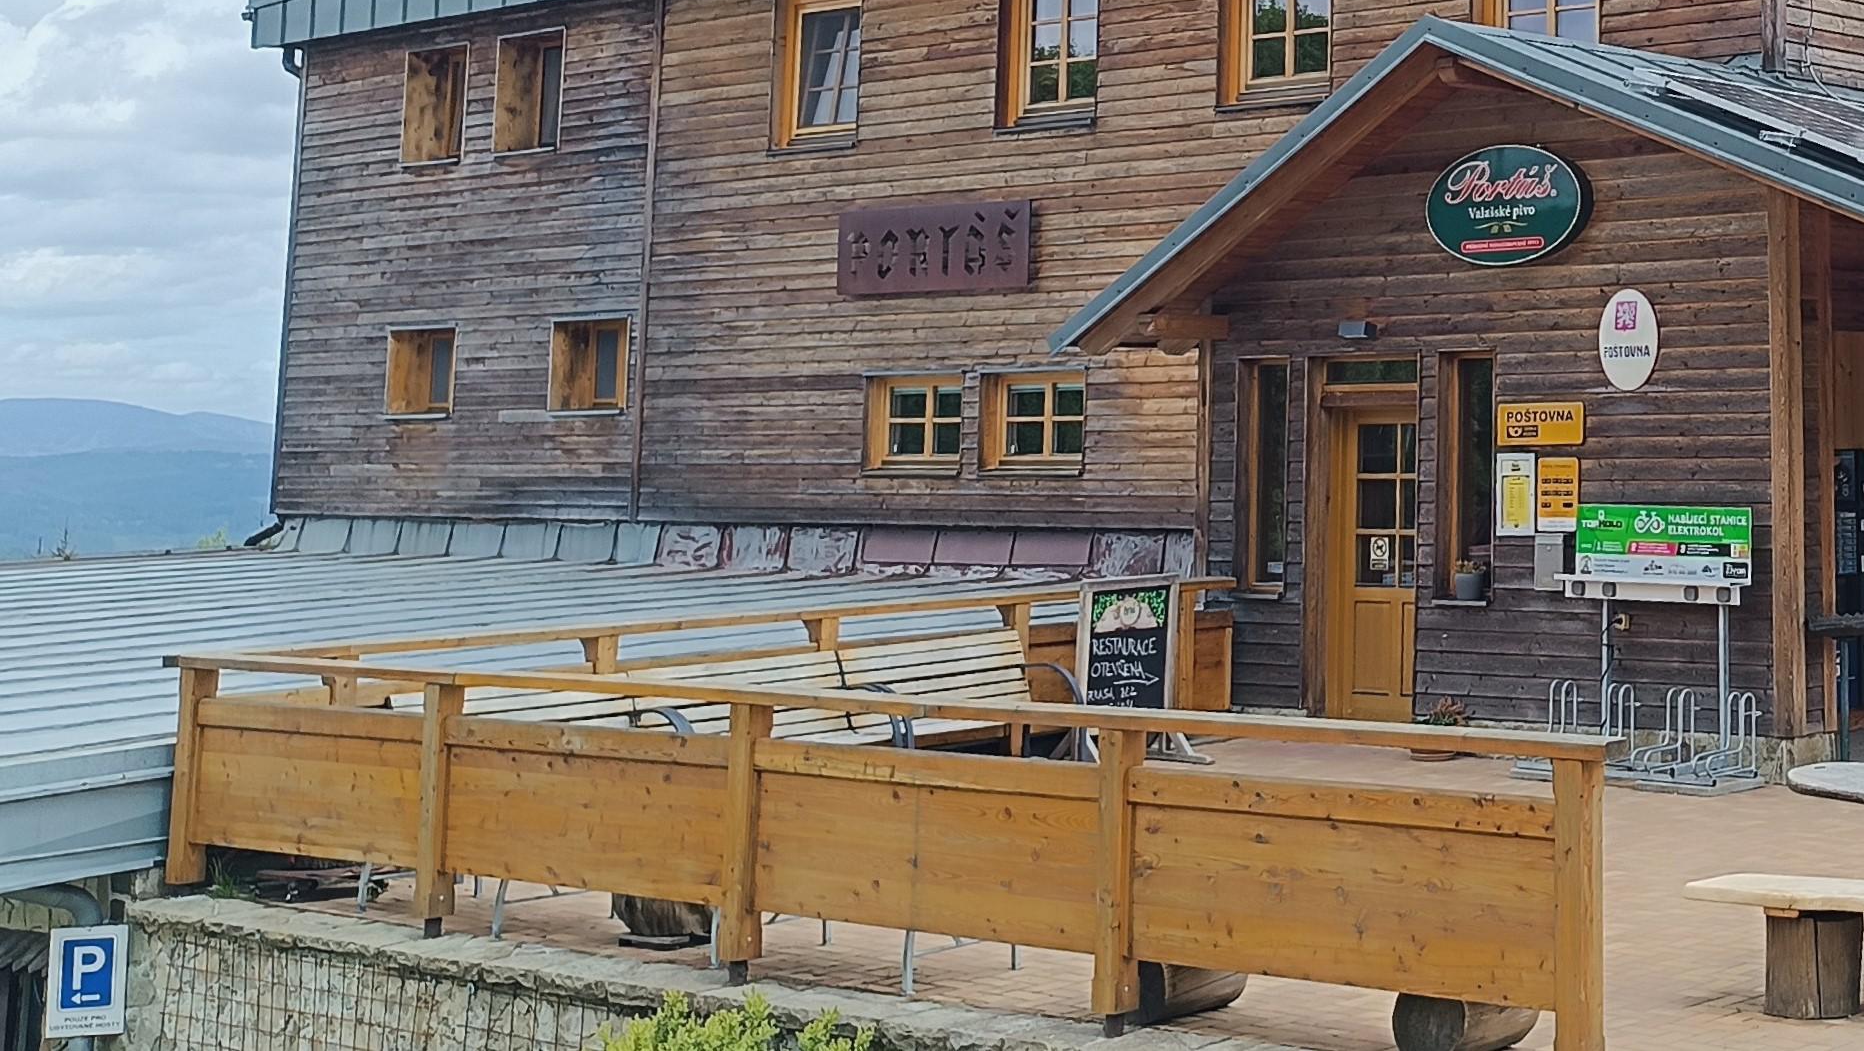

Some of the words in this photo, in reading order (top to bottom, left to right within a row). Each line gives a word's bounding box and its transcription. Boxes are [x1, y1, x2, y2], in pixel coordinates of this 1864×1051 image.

[1512, 204, 1535, 220] pivo
[1603, 343, 1651, 358] POŠTOVNA
[1506, 408, 1574, 423] POŠTOVNA
[1667, 512, 1707, 525] NABÍJECÍ
[1709, 515, 1747, 526] STANICE
[1667, 526, 1725, 537] ELEKTROKOL
[1091, 637, 1158, 657] RESTAURACE
[72, 945, 106, 990] P
